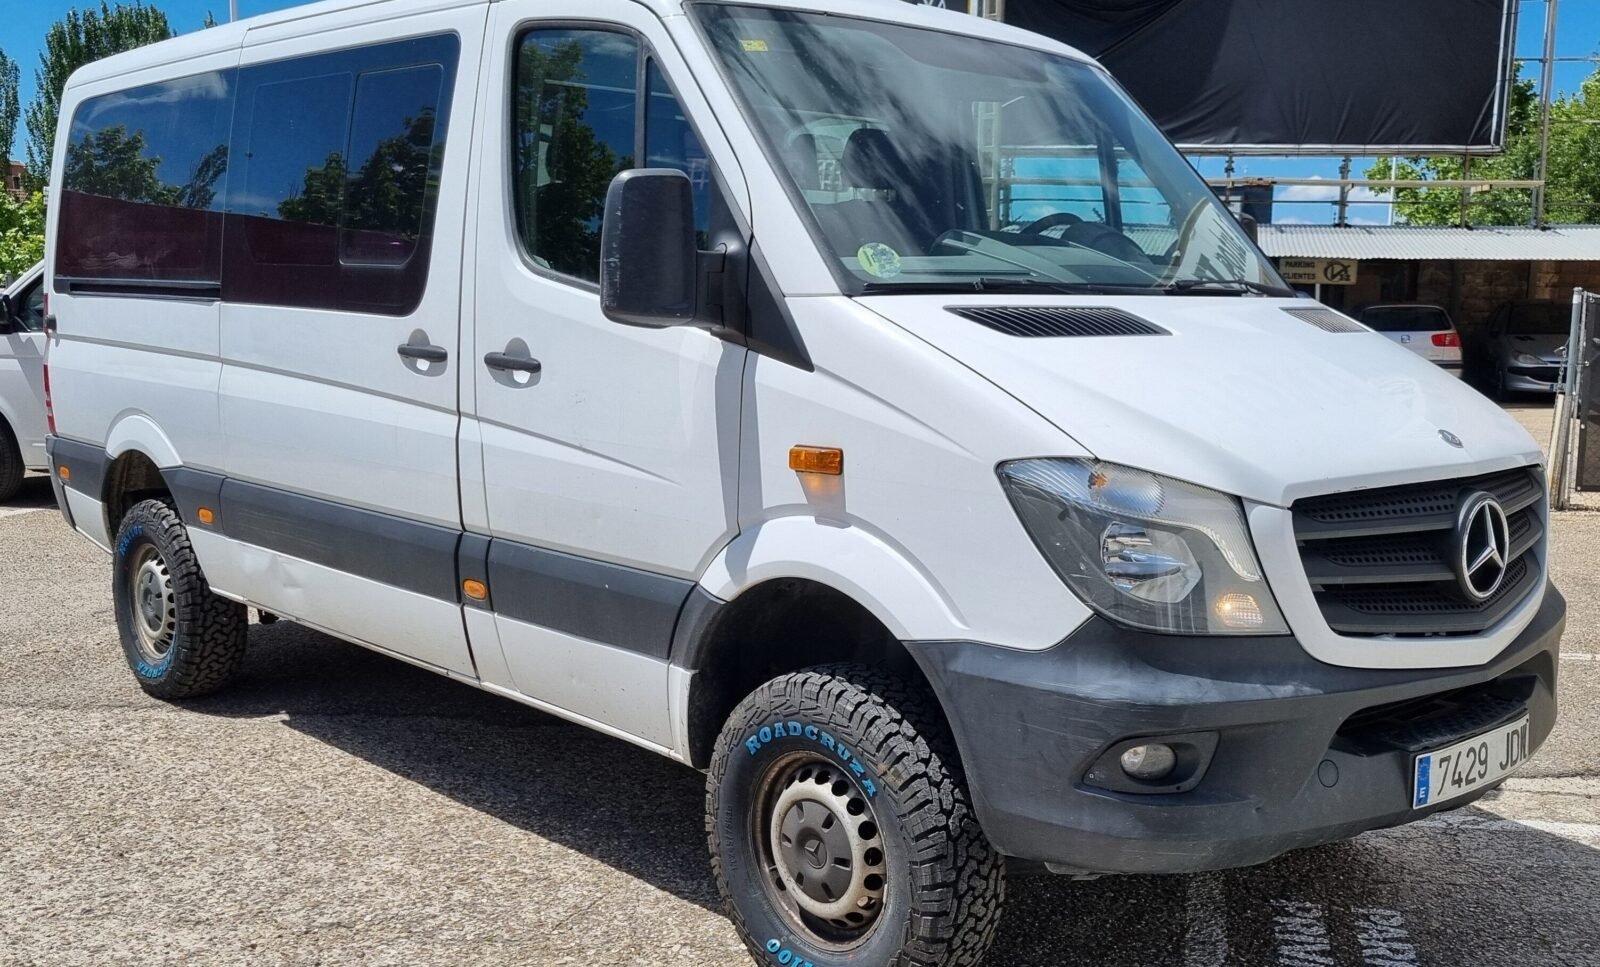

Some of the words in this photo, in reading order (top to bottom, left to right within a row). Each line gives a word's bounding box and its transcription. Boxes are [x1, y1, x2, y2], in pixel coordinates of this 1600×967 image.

[1282, 272, 1316, 280] CLIENTES
[745, 721, 877, 797] ROADCRUZA
[1437, 741, 1489, 796] 7429
[1419, 786, 1427, 798] E
